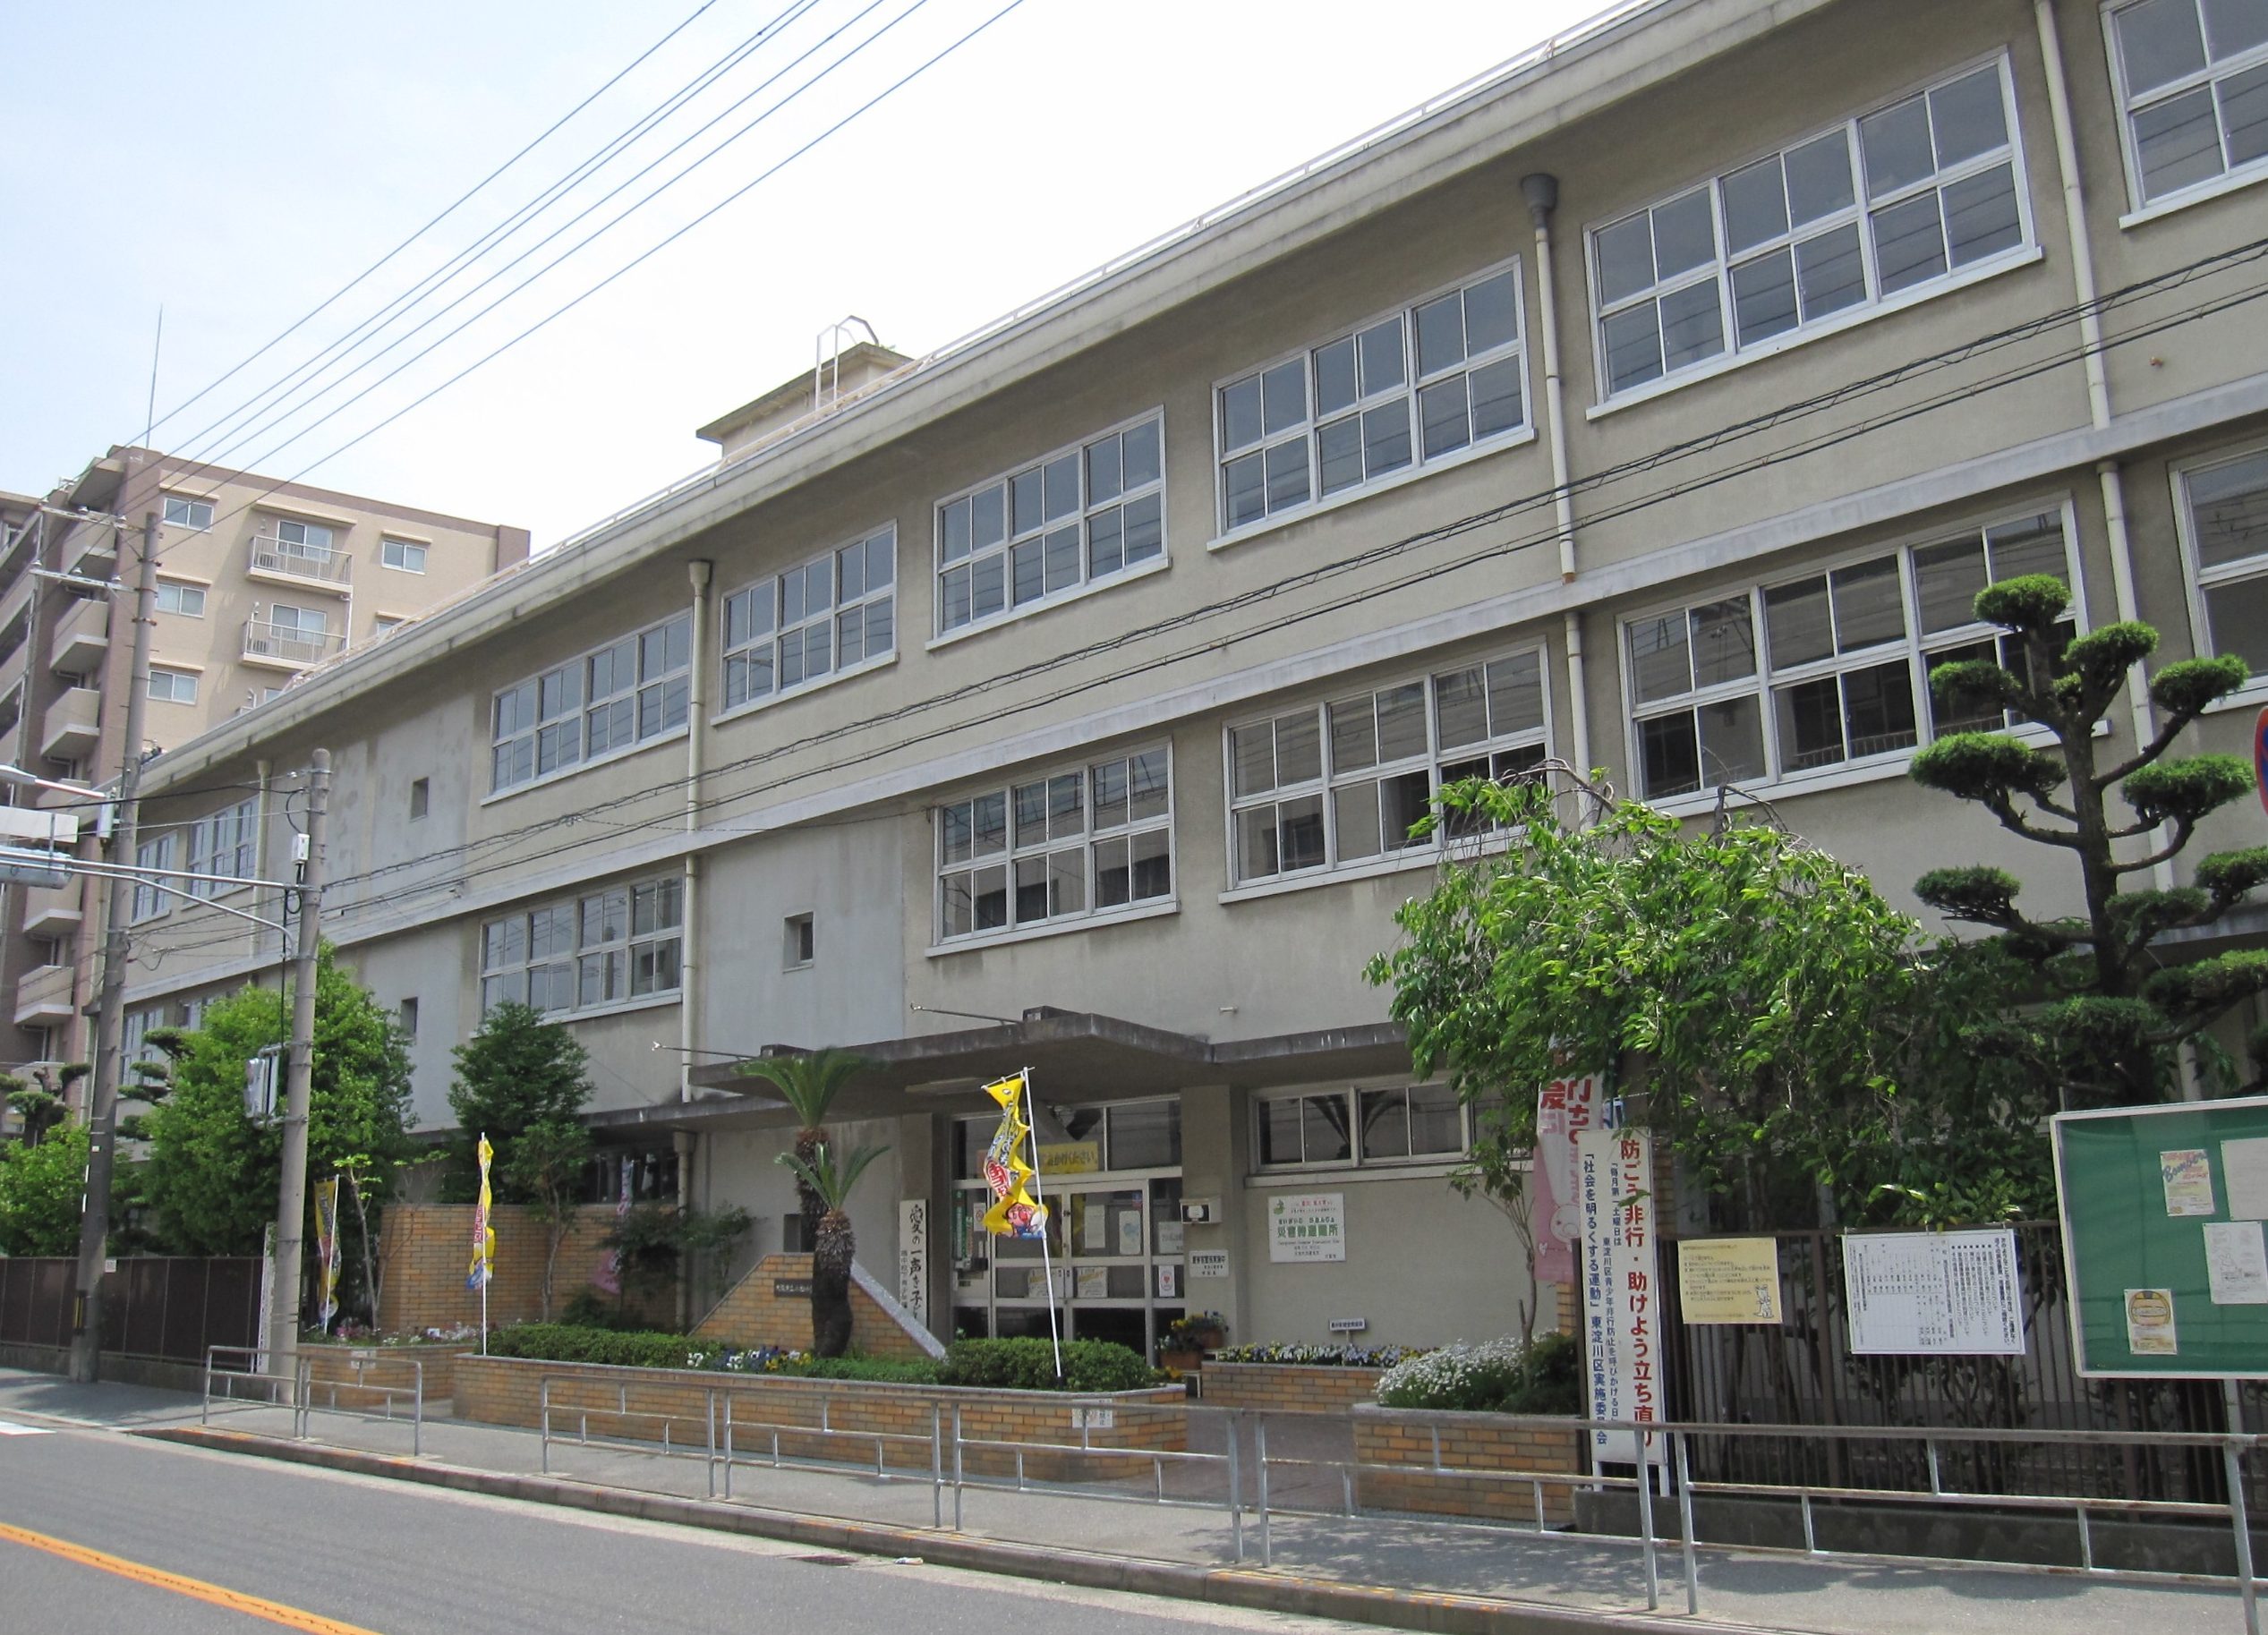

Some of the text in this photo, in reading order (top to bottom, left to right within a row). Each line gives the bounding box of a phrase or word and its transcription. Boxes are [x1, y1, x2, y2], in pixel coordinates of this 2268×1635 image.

[1583, 1153, 1601, 1307] 「社会を明るくする運動」
